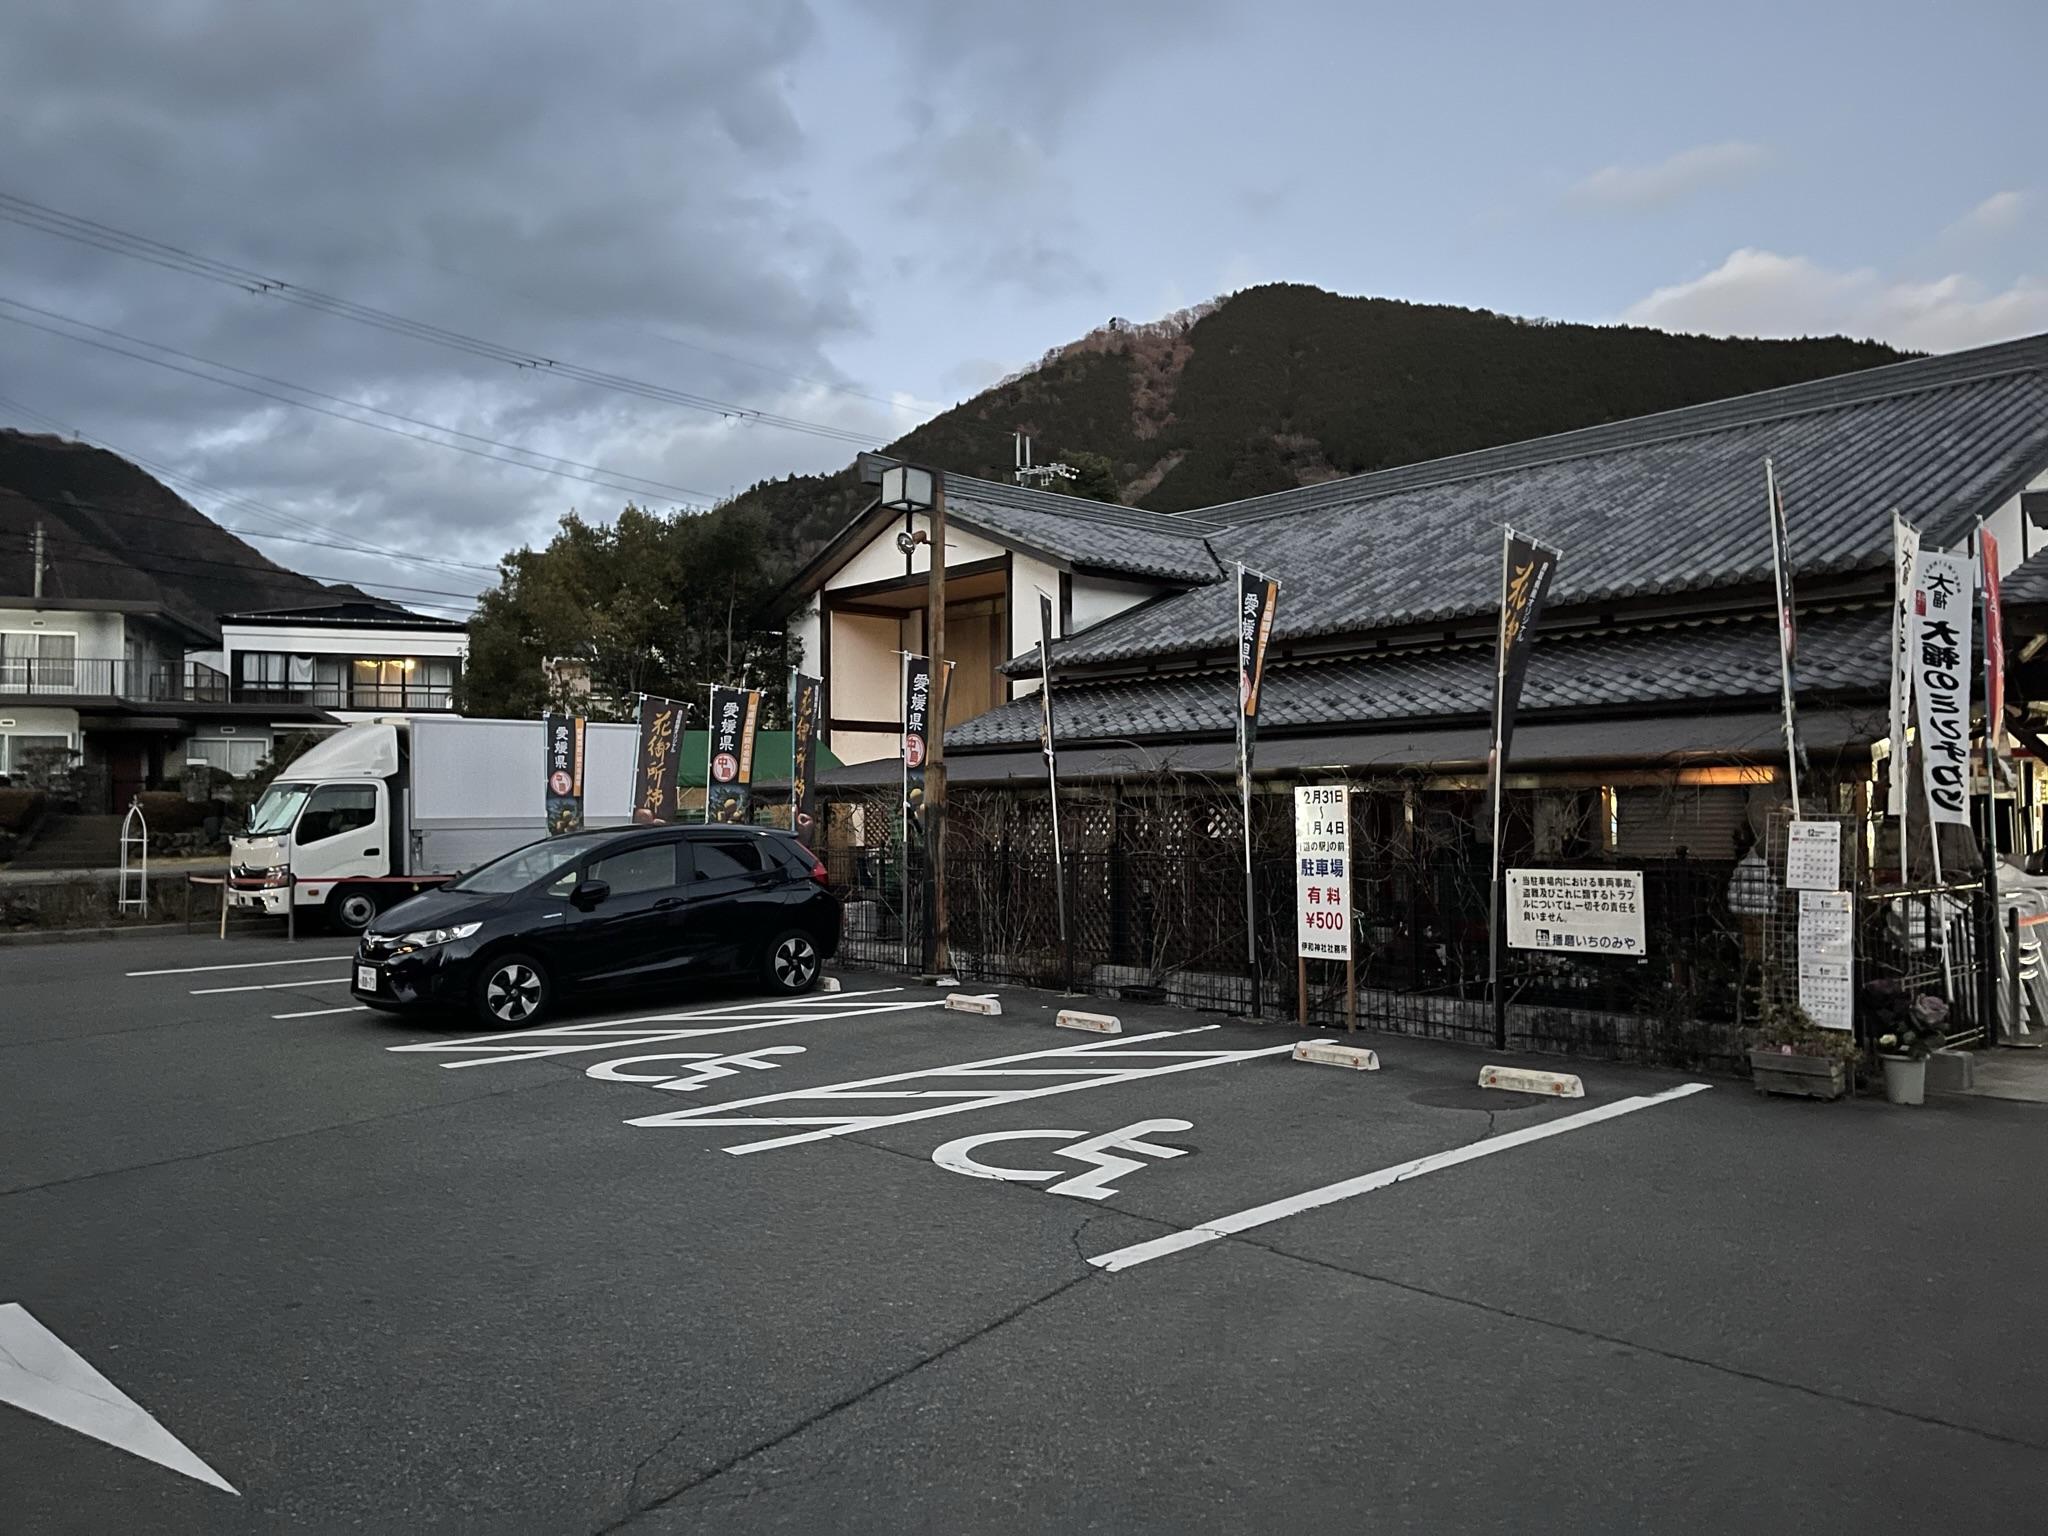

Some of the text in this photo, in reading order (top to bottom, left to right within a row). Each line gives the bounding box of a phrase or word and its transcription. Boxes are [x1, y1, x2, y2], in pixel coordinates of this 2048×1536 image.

[909, 673, 930, 731] 愛媛県
[719, 702, 739, 751] 愛媛県
[1301, 858, 1344, 878] 駐車場
[1306, 911, 1344, 930] ¥500
[1523, 912, 1567, 923] 負いません。
[1552, 934, 1636, 949] 播磨いちのみや
